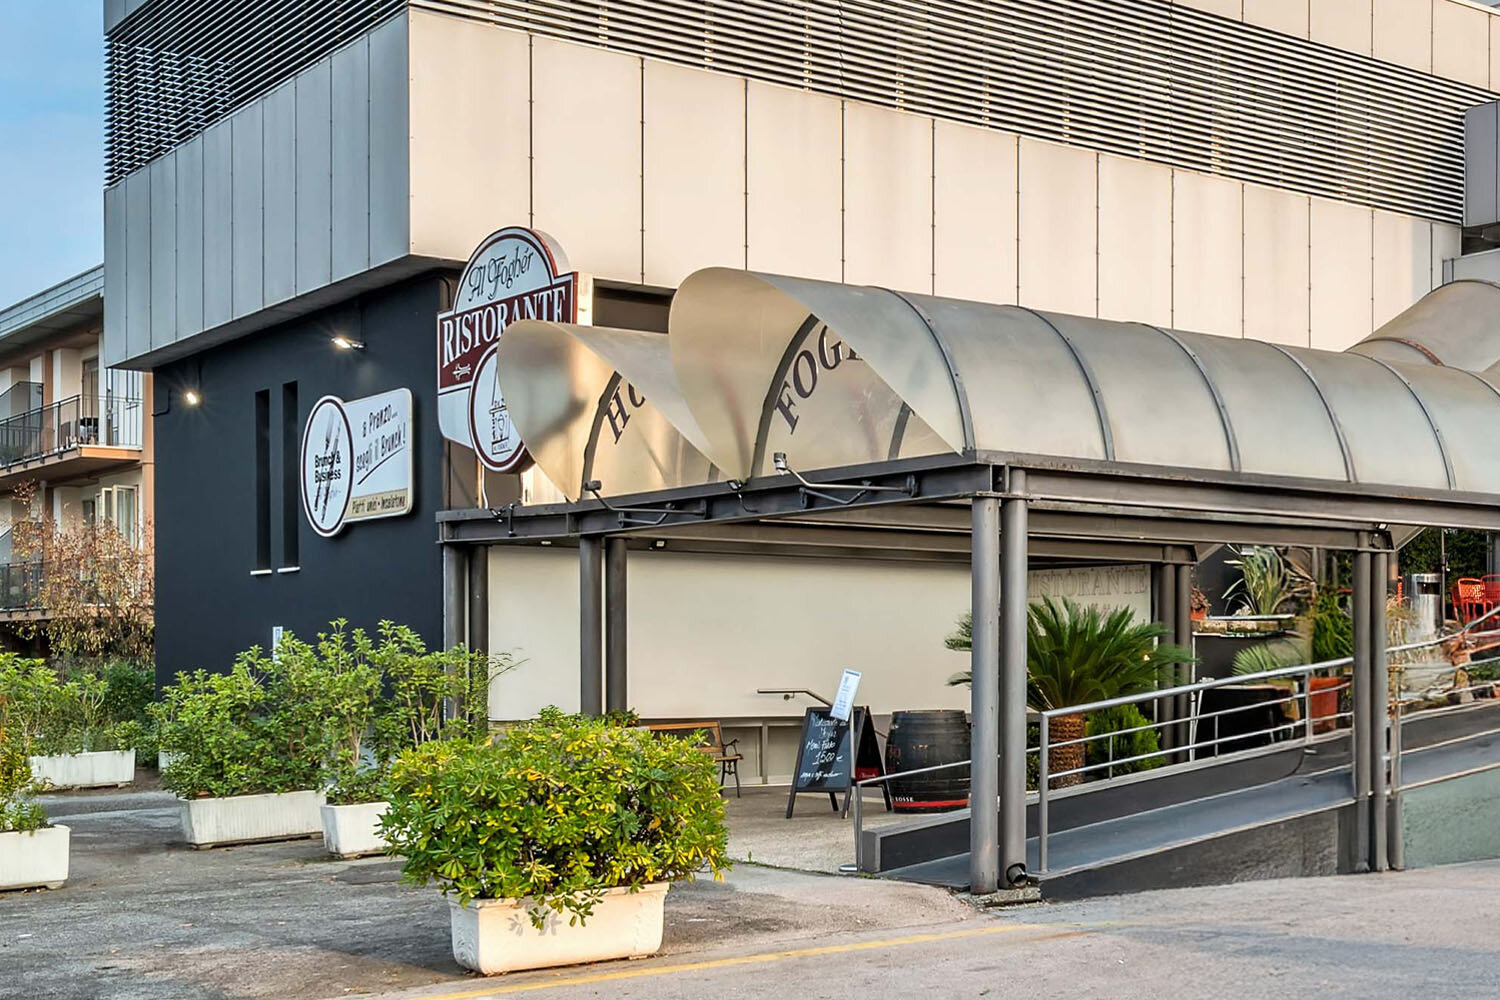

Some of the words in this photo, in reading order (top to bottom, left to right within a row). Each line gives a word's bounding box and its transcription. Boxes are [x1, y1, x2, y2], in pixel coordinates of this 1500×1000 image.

[468, 265, 486, 301] Al
[774, 325, 863, 435] FOG
[314, 451, 335, 468] Brunch
[335, 450, 342, 464] &
[314, 469, 342, 483] Business
